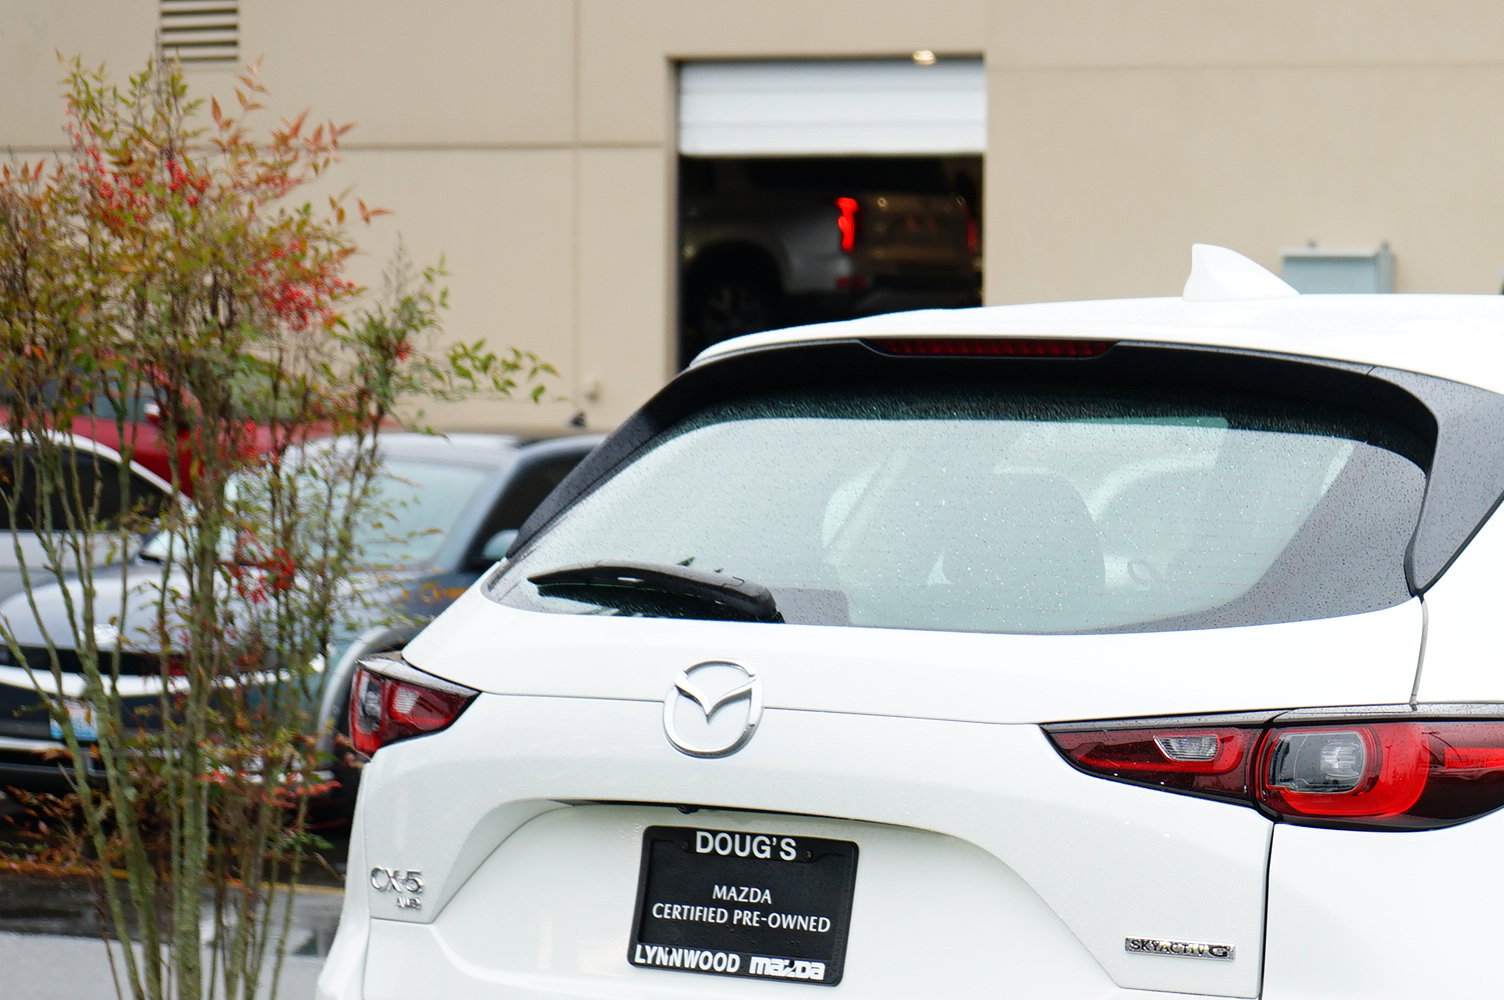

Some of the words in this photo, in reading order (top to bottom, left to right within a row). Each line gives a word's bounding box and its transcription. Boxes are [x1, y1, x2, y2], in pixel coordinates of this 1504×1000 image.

[695, 831, 797, 861] DOUG'S
[712, 884, 772, 905] MAZDA
[652, 902, 728, 924] CERTIFIED
[732, 908, 832, 933] PRE-OWNED
[634, 944, 741, 973] LYNNWOOD
